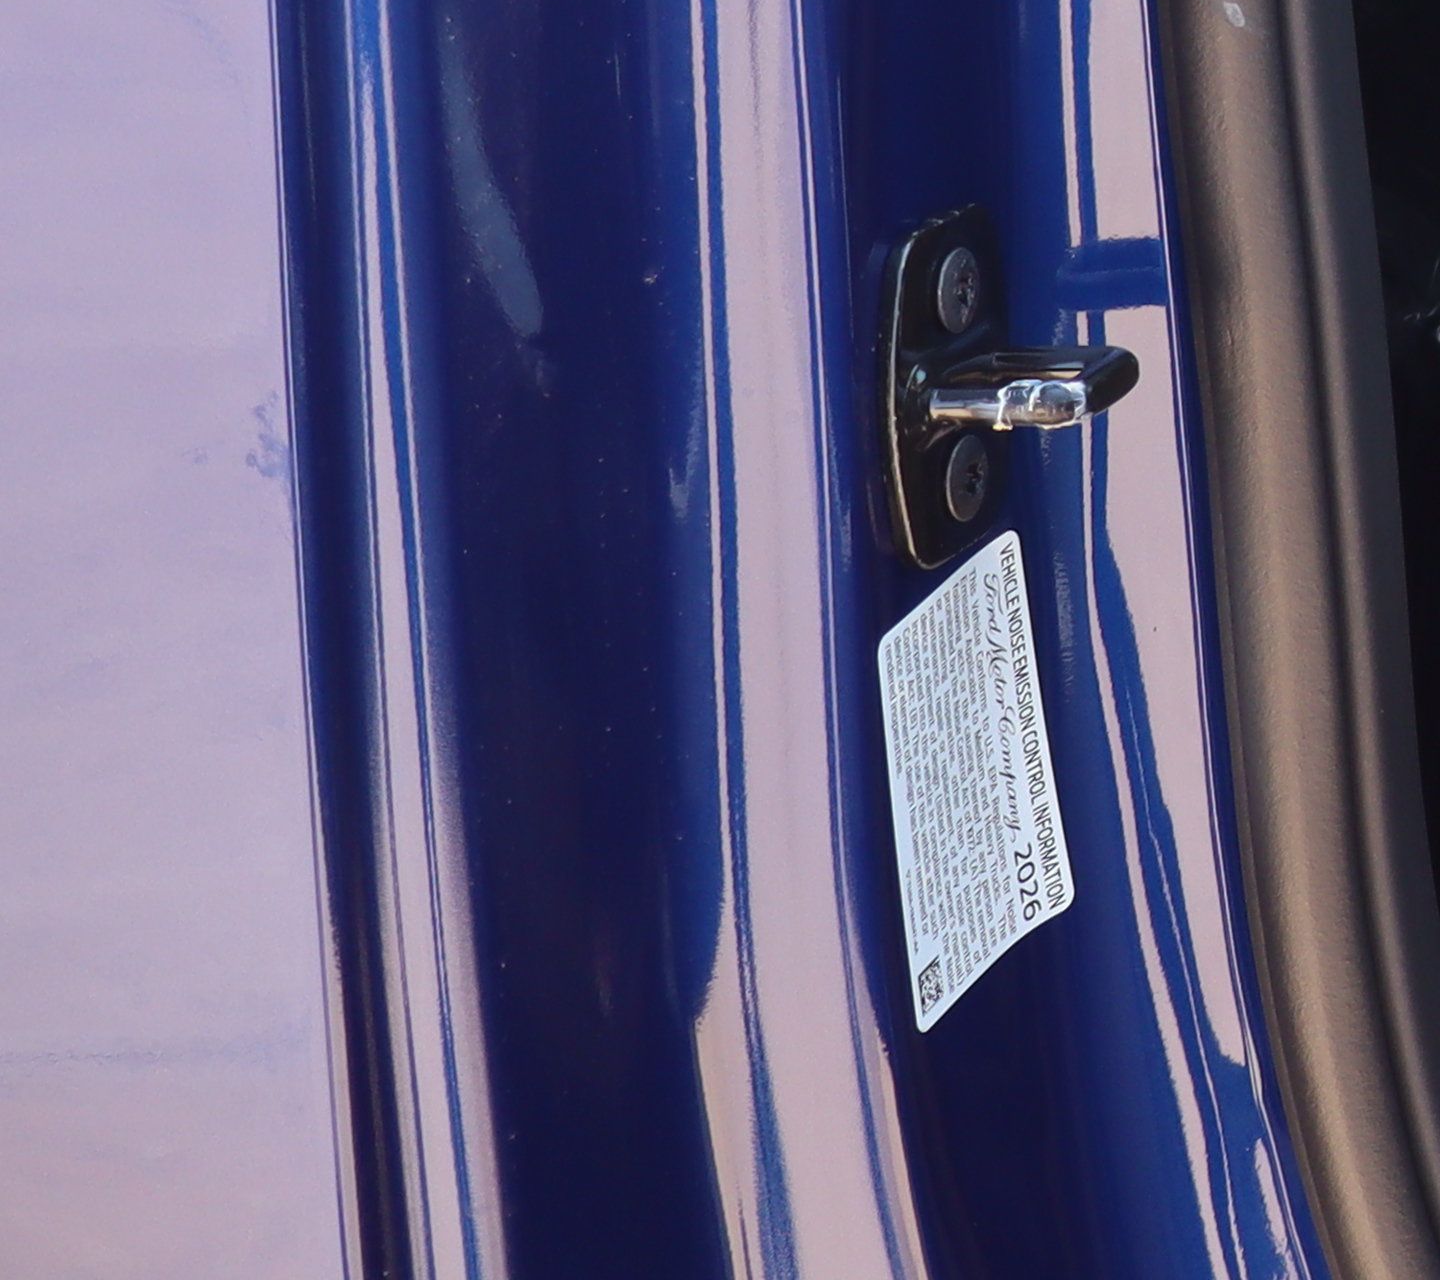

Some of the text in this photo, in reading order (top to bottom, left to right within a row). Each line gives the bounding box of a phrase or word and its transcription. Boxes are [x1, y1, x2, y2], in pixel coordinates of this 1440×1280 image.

[959, 573, 972, 635] Emission
[967, 566, 978, 597] This
[919, 609, 930, 654] device
[942, 587, 956, 659] prohibited
[949, 580, 963, 646] following
[970, 597, 982, 648] Vehicle
[884, 640, 897, 702] rendered
[893, 632, 905, 678] device
[901, 625, 914, 677] Control
[909, 617, 926, 704] incorporated
[935, 617, 950, 685] rendering
[956, 644, 967, 677] acts
[962, 635, 979, 708] Applicable
[924, 671, 936, 728] element
[975, 648, 989, 713] Conforms
[899, 691, 911, 748] element
[918, 701, 928, 733] into
[953, 697, 964, 736] Noise
[999, 540, 1066, 915] VEHICLE NOISE EMISSION CONTROL INFORMATION
[929, 745, 943, 793] design
[956, 733, 969, 785] Control
[962, 721, 977, 775] causing
[973, 727, 987, 783] Medium
[982, 571, 1042, 925] Ford Motor Company 2026
[904, 762, 917, 811] design
[922, 758, 935, 804] vehicle
[951, 770, 962, 811] other
[969, 775, 983, 826] thereof
[912, 829, 923, 866] been
[920, 825, 933, 876] vehicle
[955, 814, 967, 850] than
[981, 812, 996, 859] Heavy
[989, 794, 1009, 875] Regulations
[927, 821, 945, 900] compliance
[915, 861, 929, 923] removed
[925, 873, 937, 908] after
[937, 897, 949, 931] with
[955, 889, 967, 928] noise
[961, 882, 978, 946] purposes
[980, 877, 995, 925] person
[1005, 896, 1018, 936] Noise
[929, 906, 941, 941] such
[976, 905, 992, 961] removal
[944, 954, 958, 996] Noise
[959, 927, 974, 978] control
